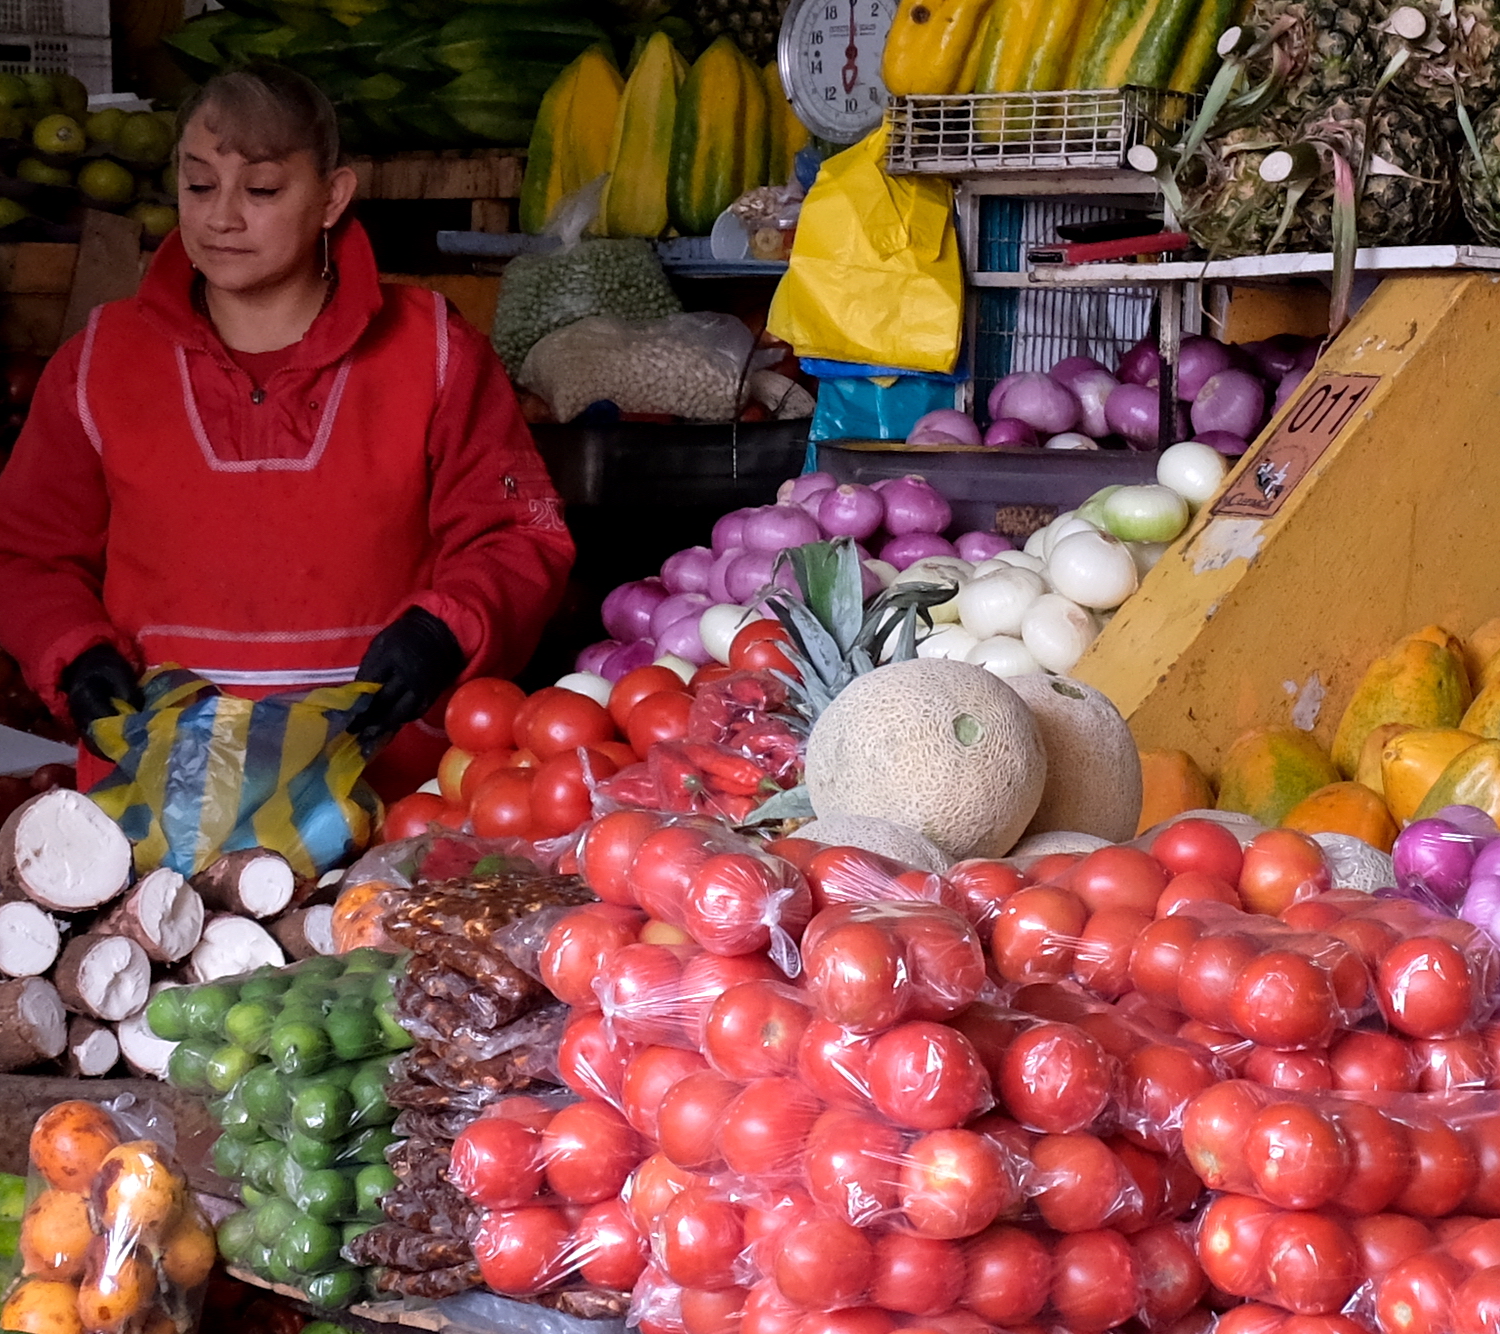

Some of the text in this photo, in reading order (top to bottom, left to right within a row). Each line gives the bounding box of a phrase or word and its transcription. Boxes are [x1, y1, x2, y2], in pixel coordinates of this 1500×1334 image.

[825, 6, 838, 20] 18
[871, 3, 879, 17] 2
[811, 31, 823, 45] 16
[811, 61, 823, 74] 14
[825, 87, 836, 101] 12
[845, 99, 858, 113] 10
[1288, 384, 1368, 435] 011
